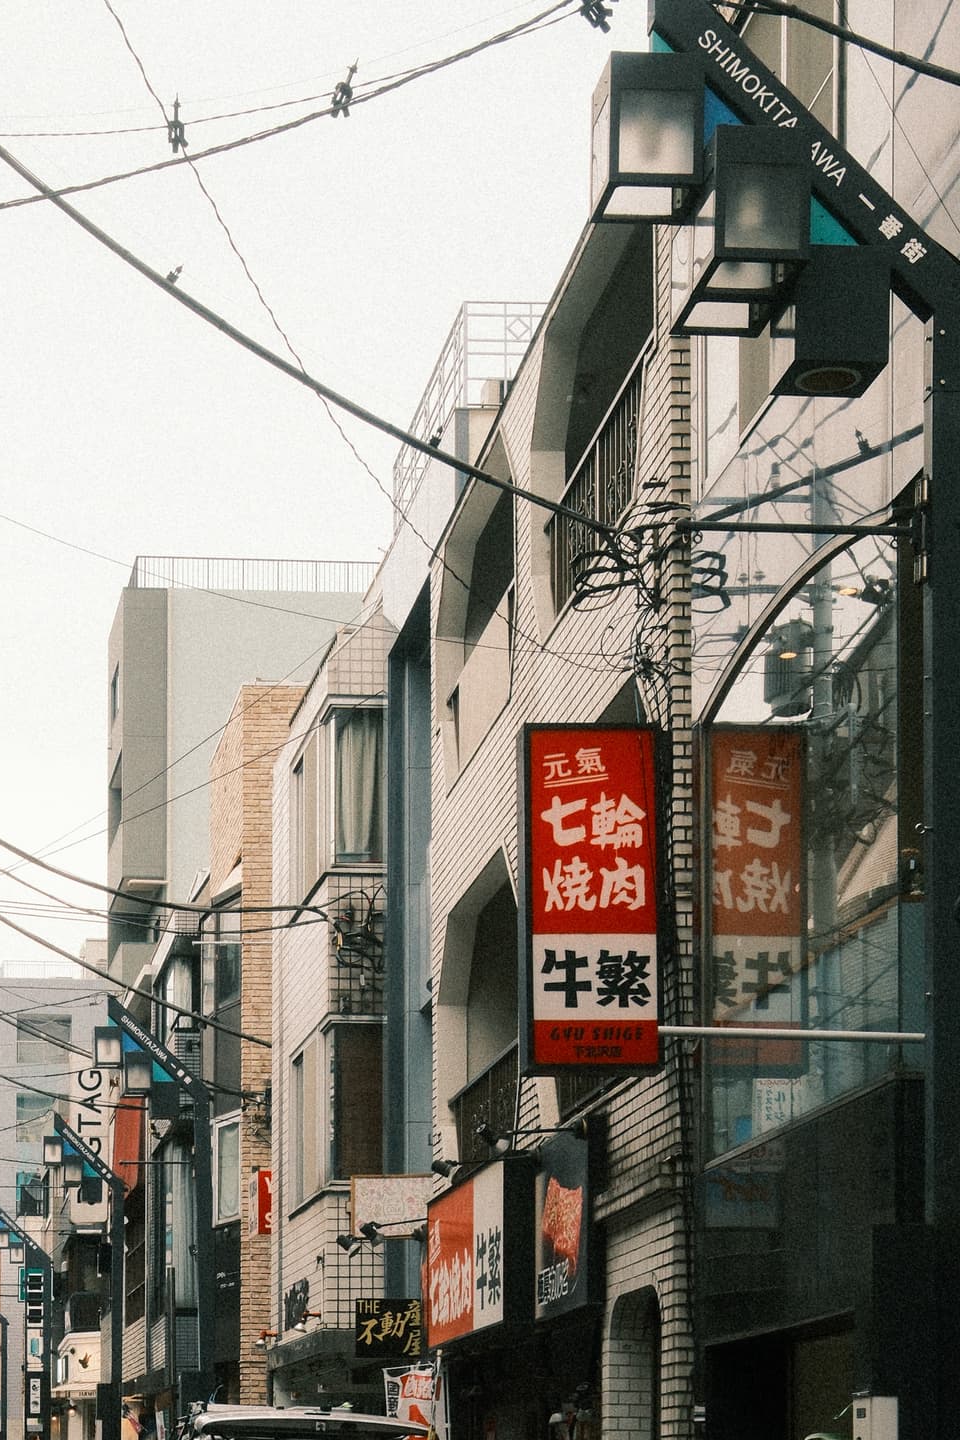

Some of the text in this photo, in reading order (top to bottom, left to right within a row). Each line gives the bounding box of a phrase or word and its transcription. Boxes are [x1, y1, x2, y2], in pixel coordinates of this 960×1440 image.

[697, 29, 929, 265] SHIMOKITAAWA 一番街
[543, 747, 606, 781] 元氣
[541, 792, 647, 850] 七輪
[542, 858, 646, 912] 焼肉
[541, 948, 652, 1009] 牛繁
[592, 1026, 645, 1041] SHIGE
[476, 1226, 501, 1310] 牛繁
[357, 1299, 381, 1314] THE
[357, 1300, 421, 1357] 不動産屋
